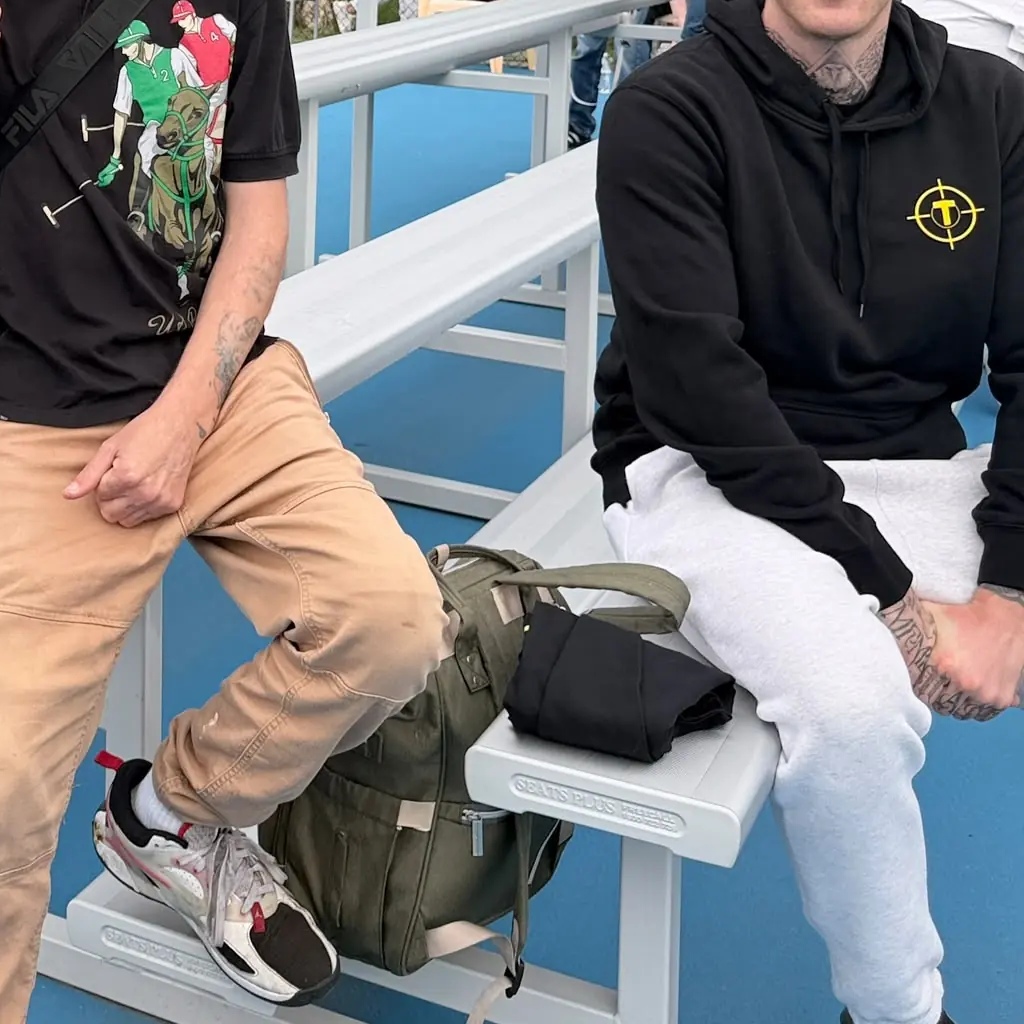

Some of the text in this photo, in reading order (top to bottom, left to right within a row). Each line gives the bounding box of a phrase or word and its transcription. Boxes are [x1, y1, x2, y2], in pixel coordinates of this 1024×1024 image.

[210, 31, 220, 42] 4
[160, 69, 170, 82] 2
[1, 88, 59, 147] FILA
[515, 778, 616, 814] SEATS PLUS
